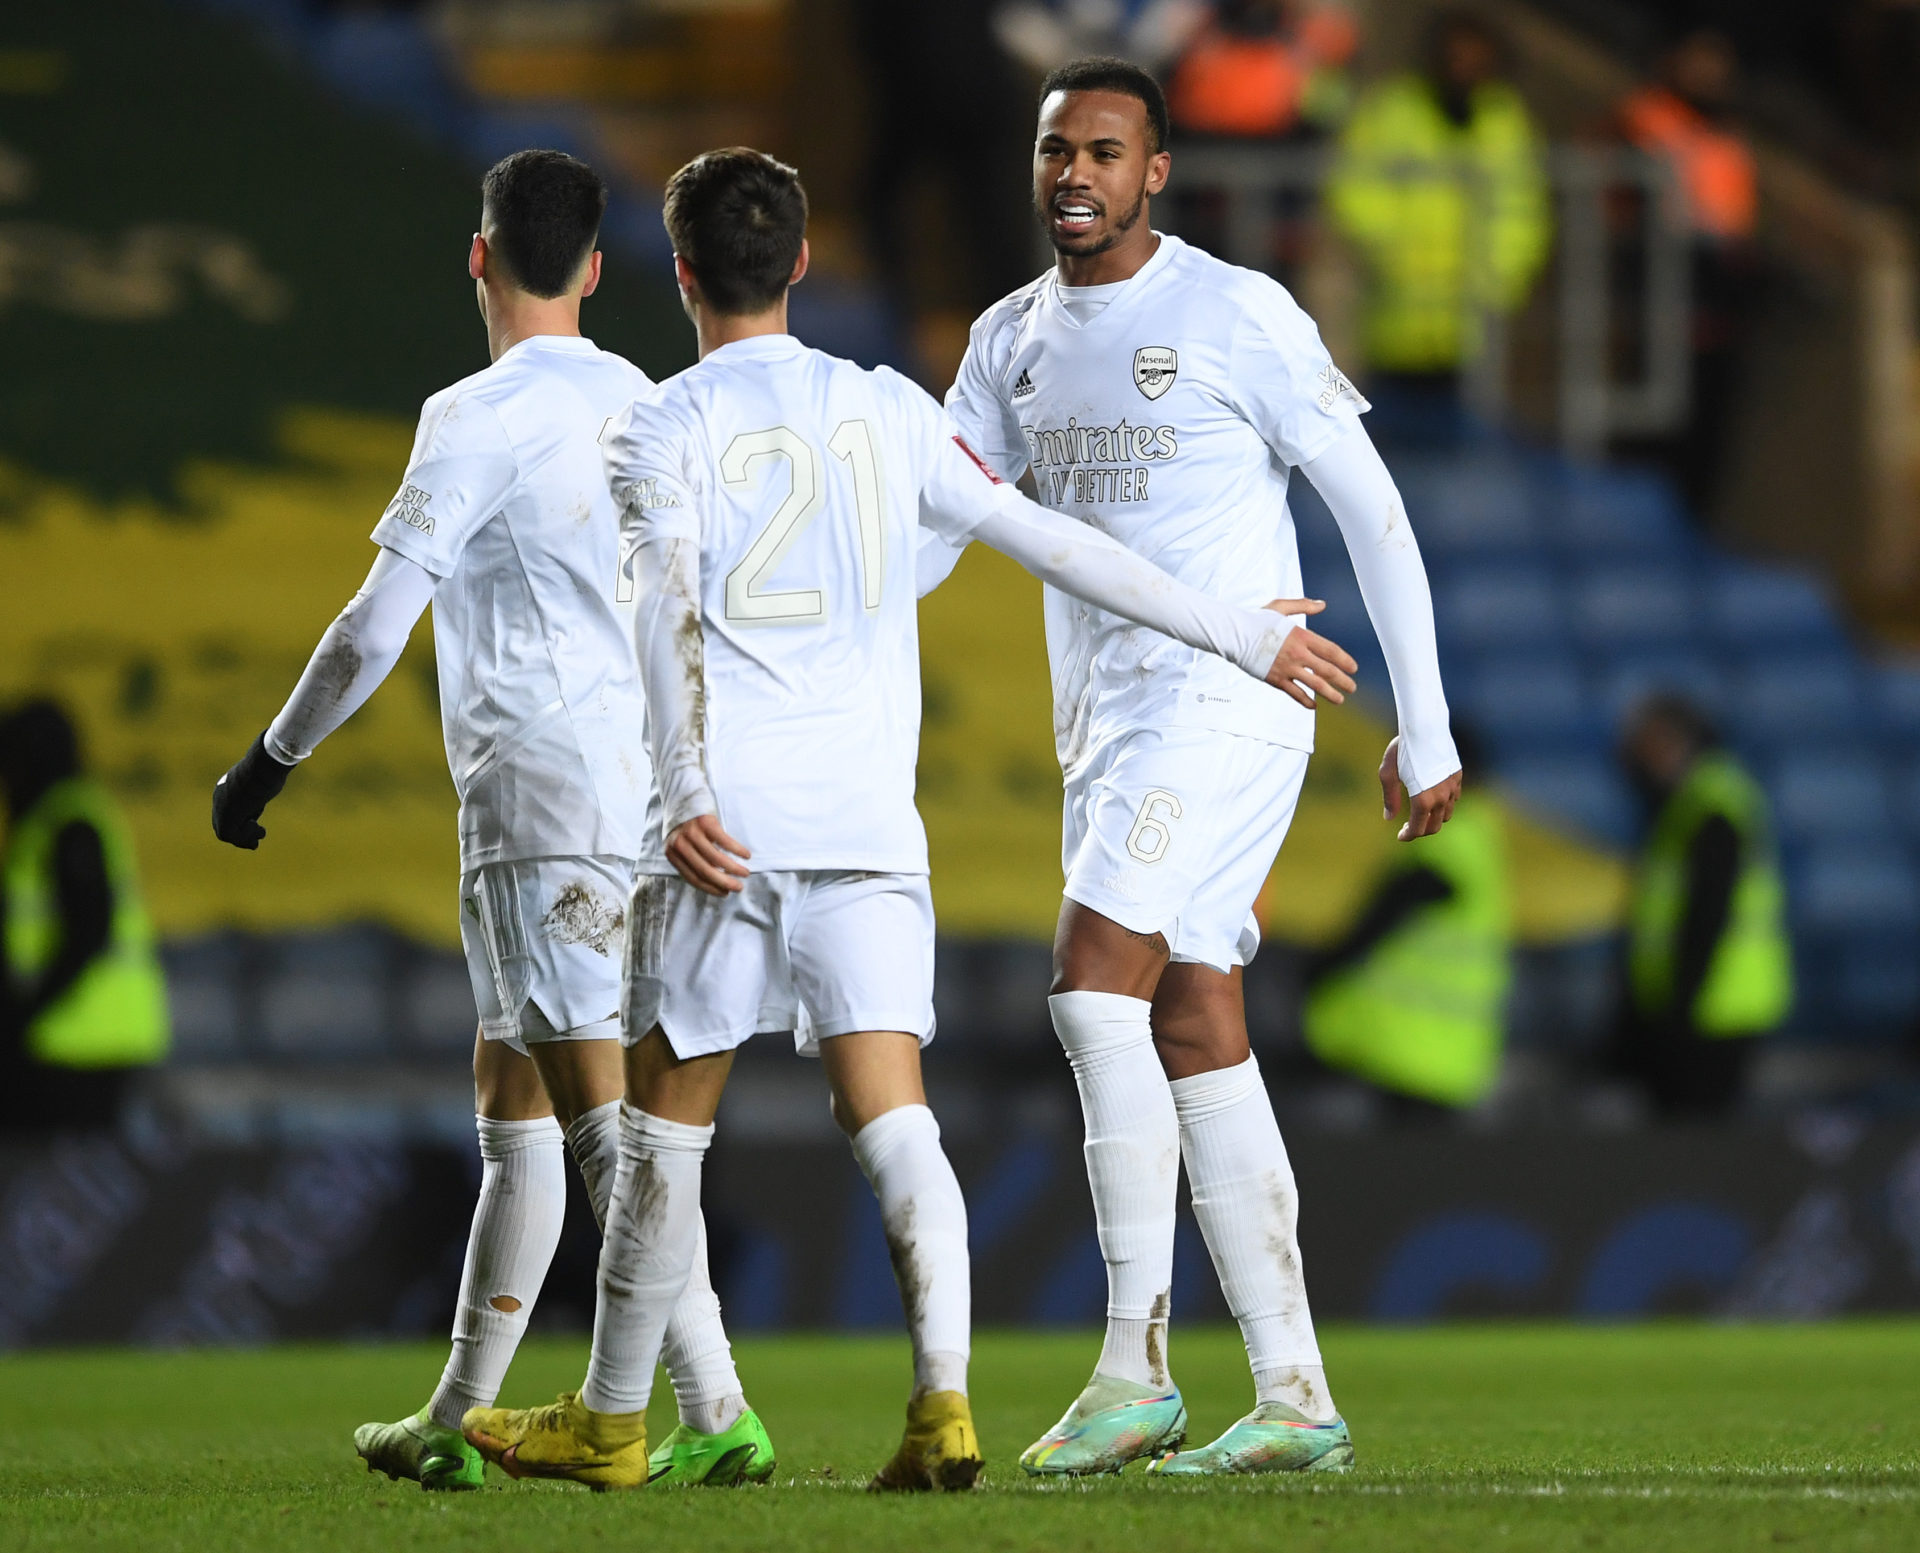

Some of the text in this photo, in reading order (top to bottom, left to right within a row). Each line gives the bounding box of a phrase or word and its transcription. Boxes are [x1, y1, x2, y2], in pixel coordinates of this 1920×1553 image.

[1140, 355, 1172, 364] Arsenal
[1013, 384, 1036, 399] adidas
[400, 485, 433, 510] SIT
[1073, 467, 1149, 503] BETTER
[721, 418, 884, 622] 21
[1125, 789, 1183, 864] 6
